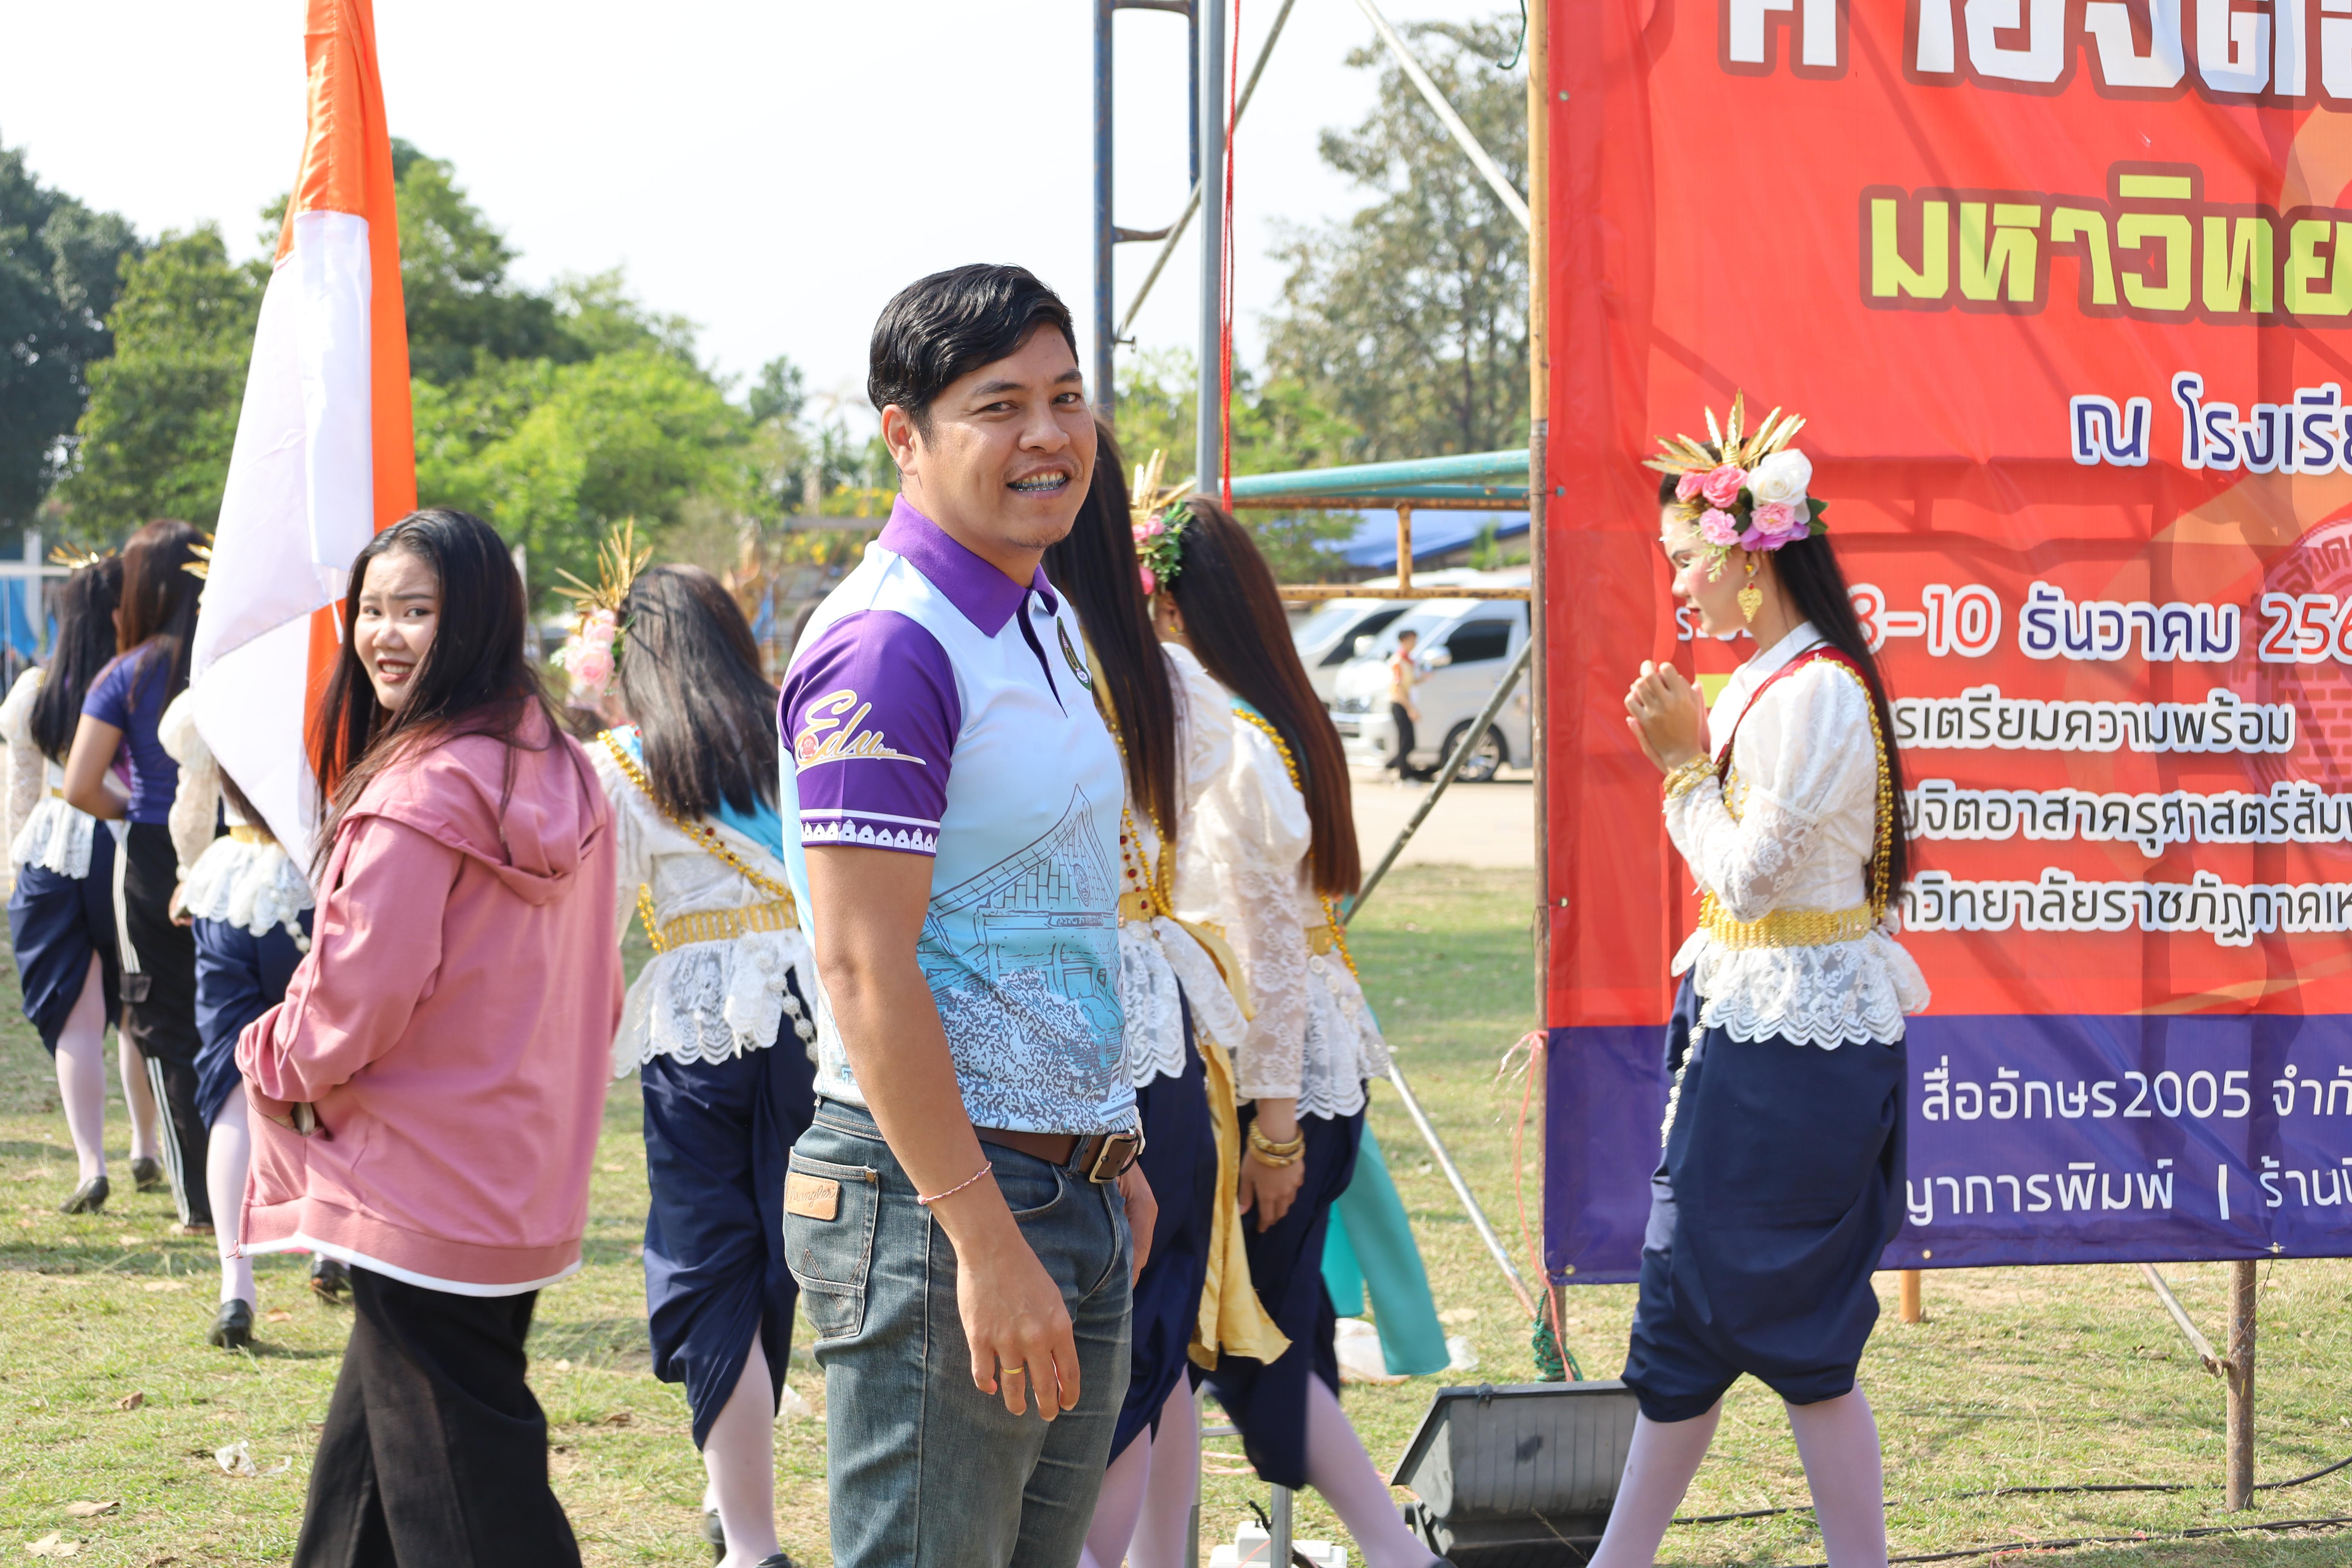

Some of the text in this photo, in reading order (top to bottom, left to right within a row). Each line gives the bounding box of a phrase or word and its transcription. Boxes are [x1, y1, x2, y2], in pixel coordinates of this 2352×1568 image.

[2077, 380, 2352, 466] ณ โรงเรี
[2027, 590, 2233, 654] ธันวาคม
[1895, 694, 2290, 745] รเตรียมความพร้อม
[1906, 788, 2352, 850] จิตอาสาครุศาสตร์สัม
[1922, 1055, 2251, 1121] สื่ออักษร2005
[787, 1185, 836, 1208] Wrangler
